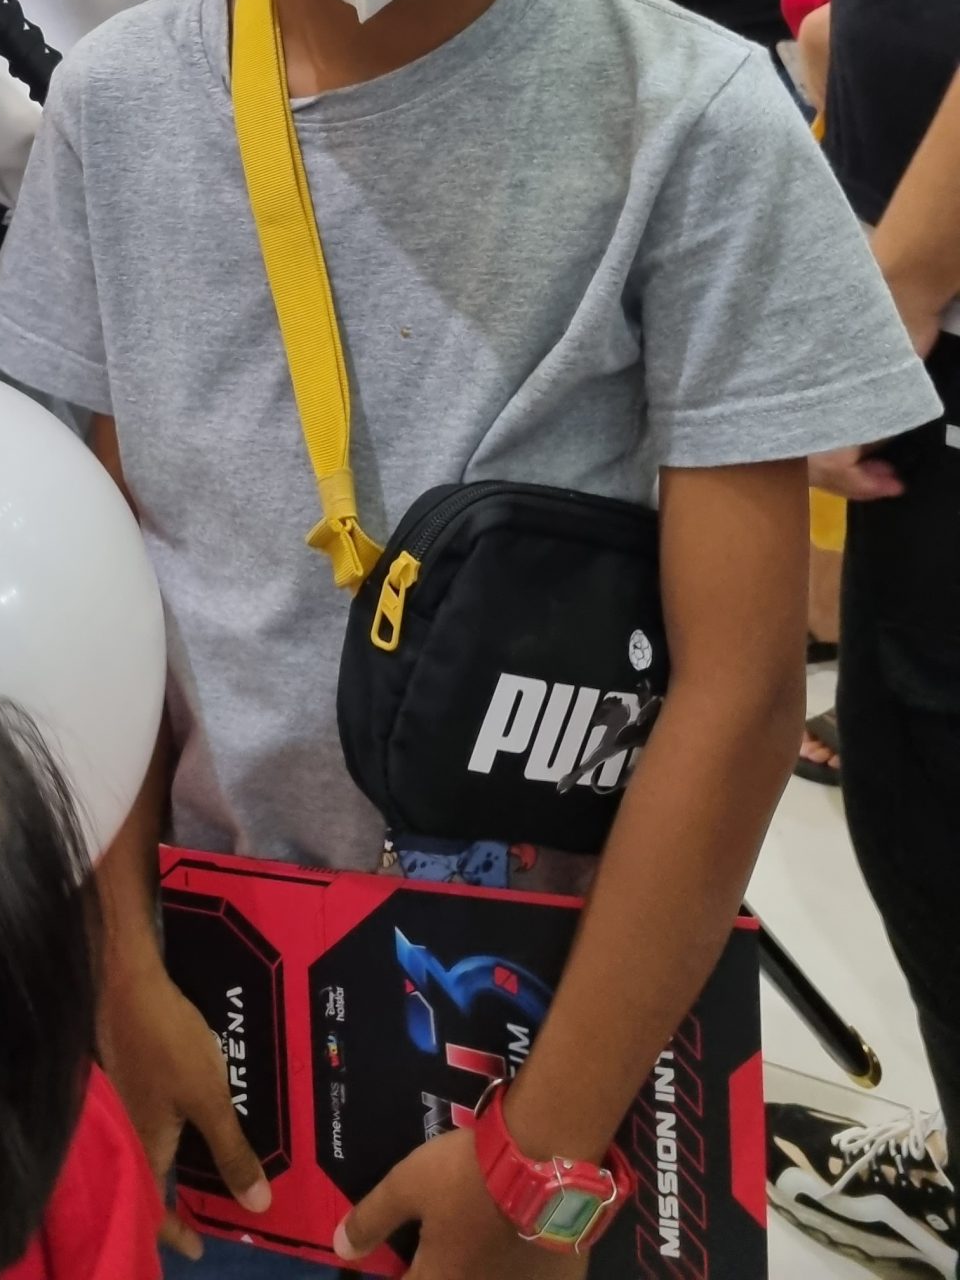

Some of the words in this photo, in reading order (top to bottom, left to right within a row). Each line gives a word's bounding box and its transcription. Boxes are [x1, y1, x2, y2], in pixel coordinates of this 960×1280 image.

[467, 672, 644, 787] PUM
[226, 986, 248, 1116] ARENA
[654, 1037, 676, 1103] INT
[330, 1081, 345, 1160] primeworks
[655, 1111, 681, 1259] MISSION
